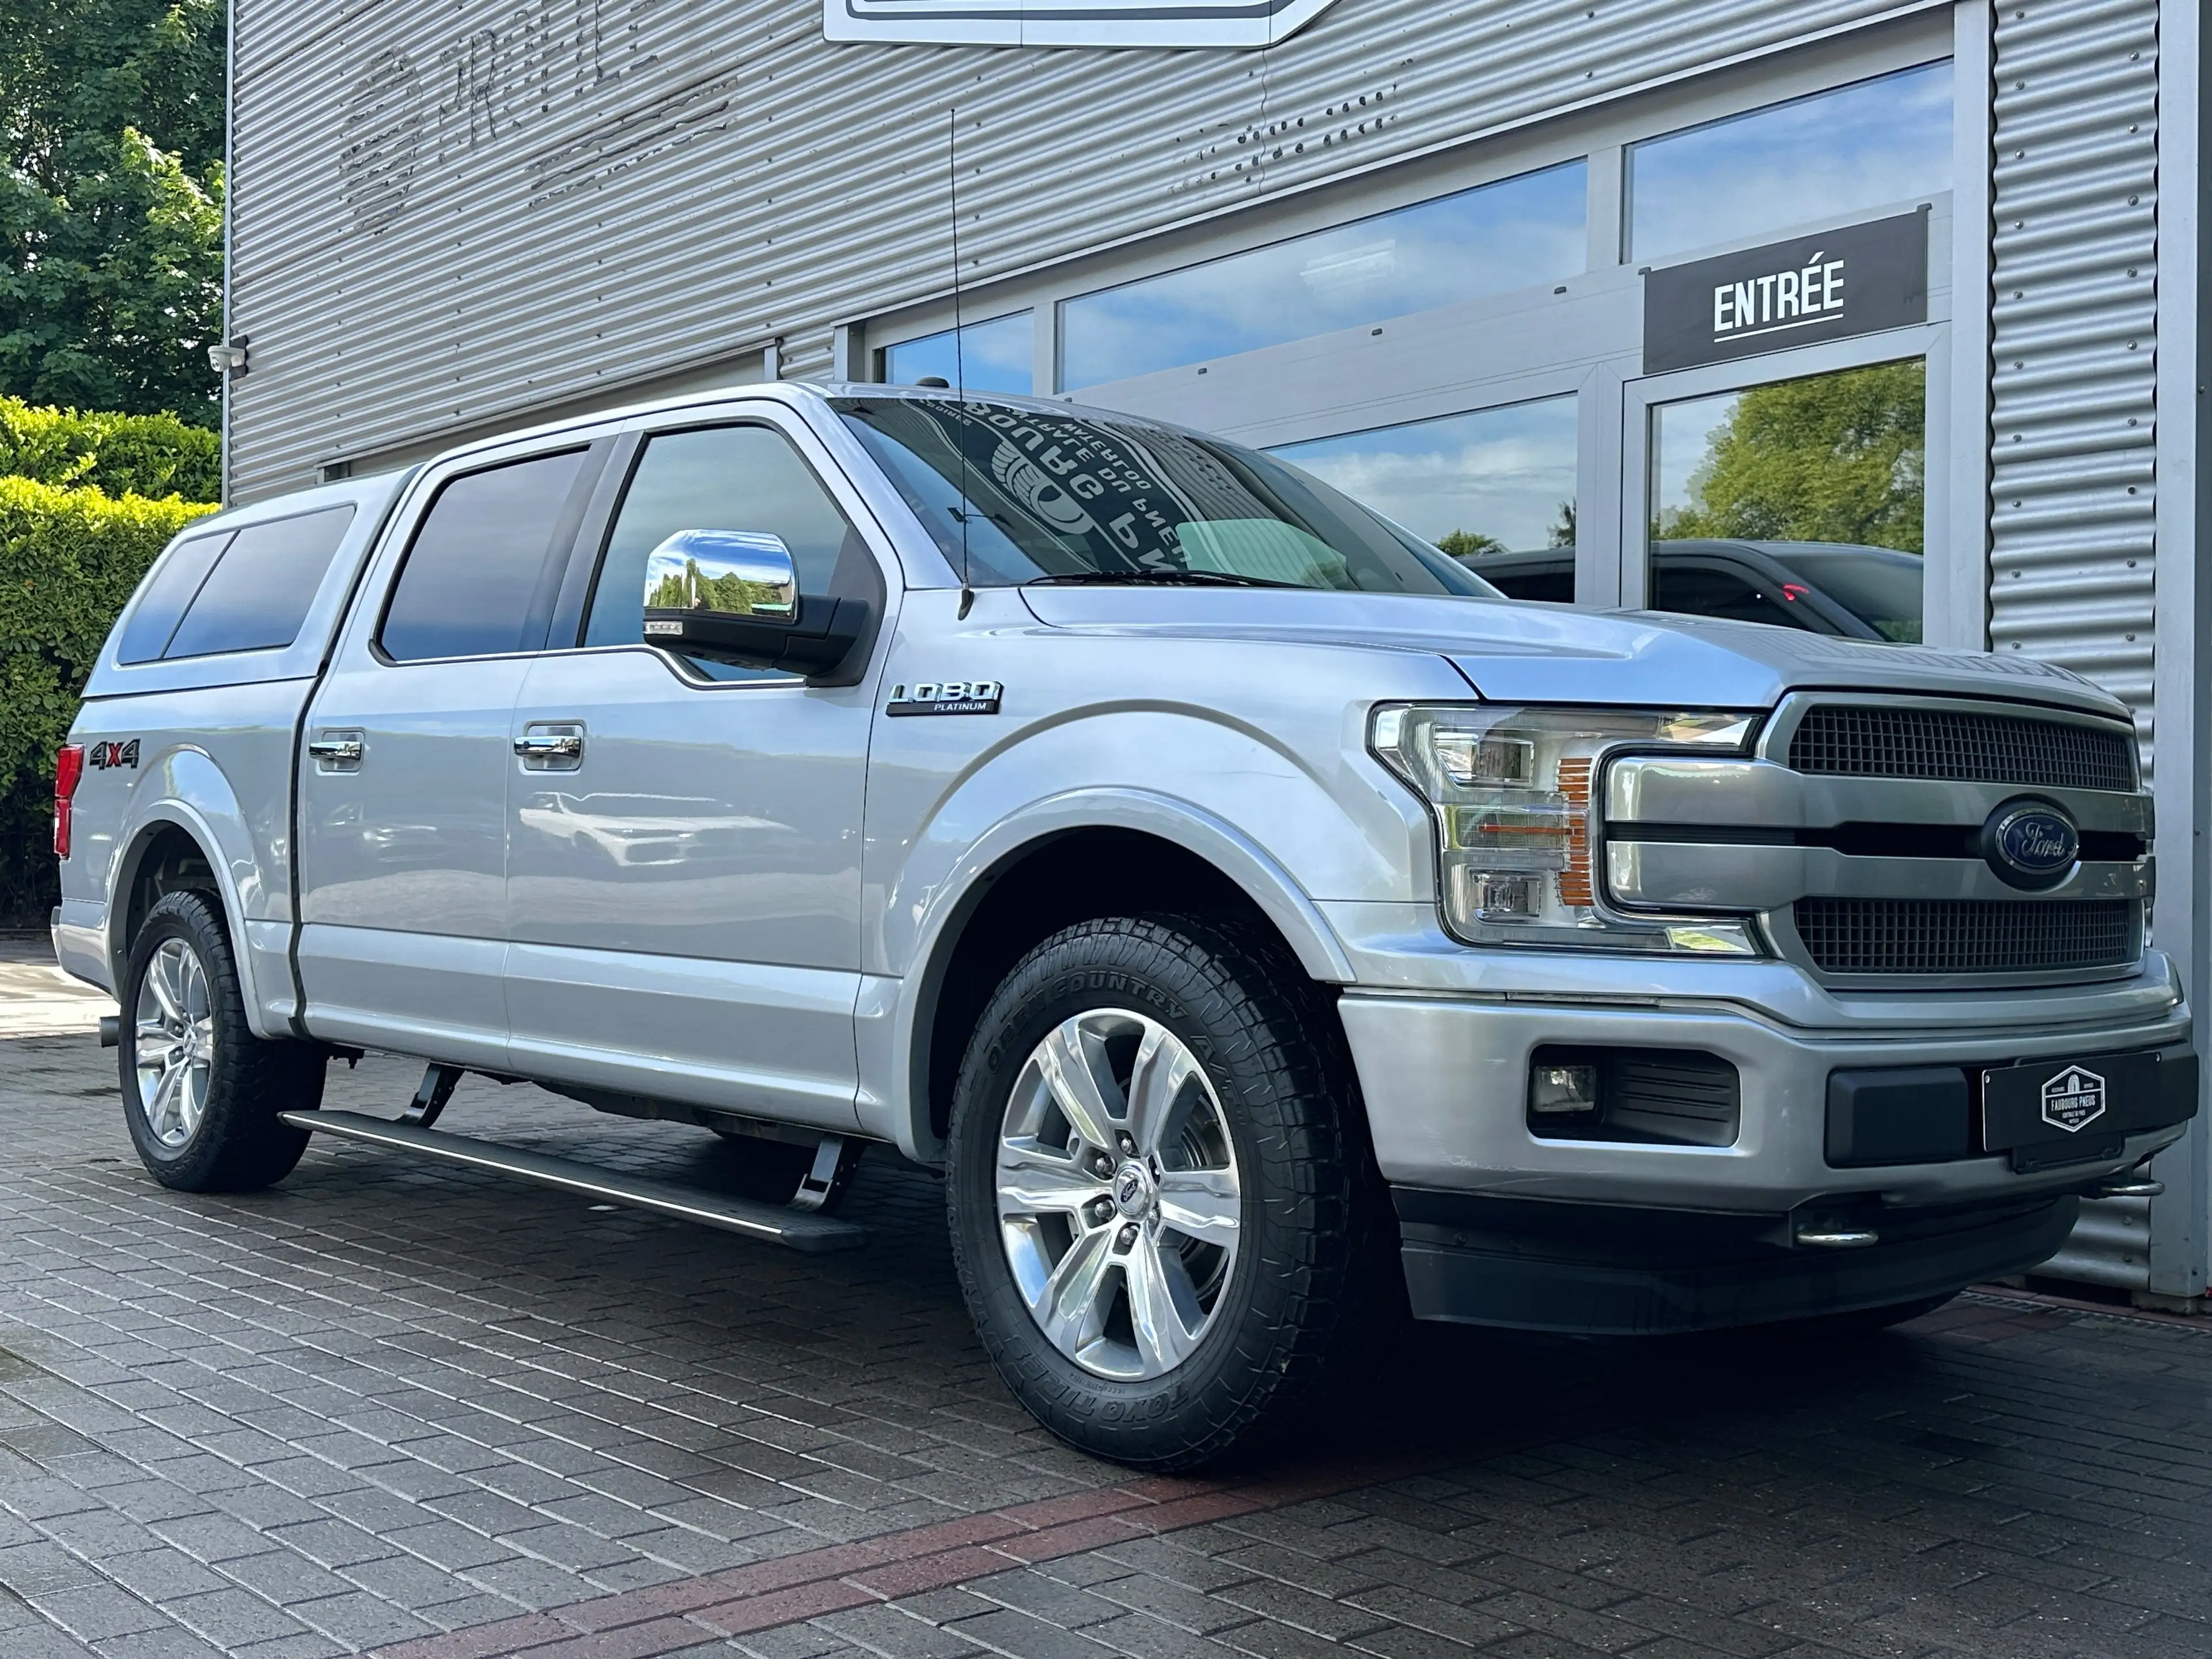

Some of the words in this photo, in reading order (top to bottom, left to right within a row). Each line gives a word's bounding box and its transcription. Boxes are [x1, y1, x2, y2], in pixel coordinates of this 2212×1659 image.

[1714, 251, 1844, 332] ENTRÉE
[887, 681, 1002, 703] LOBO
[934, 702, 987, 711] PLATINUM
[2021, 821, 2066, 858] Ford
[1051, 970, 1188, 1020] COUNTRY
[1004, 1334, 1097, 1417] TIRES
[1100, 1385, 1189, 1423] TOYO
